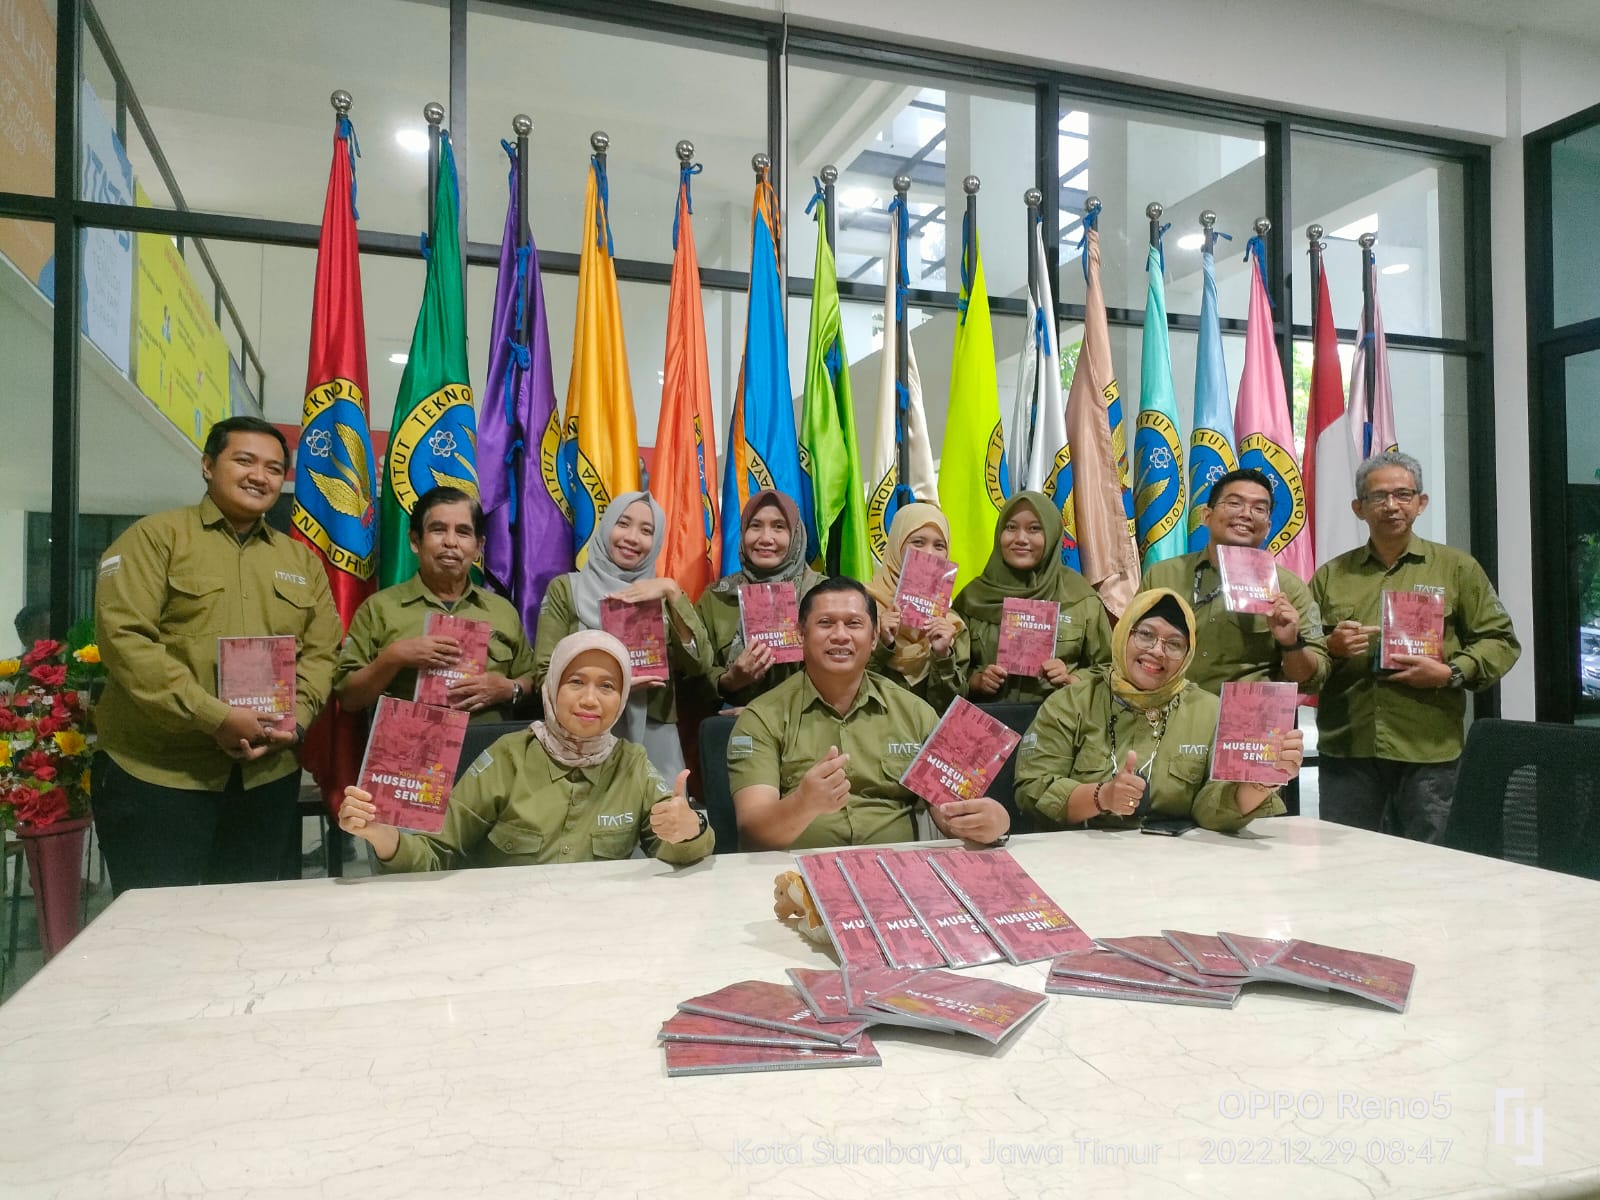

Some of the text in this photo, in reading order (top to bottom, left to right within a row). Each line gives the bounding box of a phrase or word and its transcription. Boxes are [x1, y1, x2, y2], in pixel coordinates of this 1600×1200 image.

[582, 467, 608, 520] BAYA
[274, 570, 306, 585] ITATS
[229, 695, 276, 706] MUSEUM
[888, 743, 921, 754] ITATS
[1223, 742, 1270, 752] MUSEUM
[1243, 752, 1269, 761] SENI
[927, 754, 968, 785] MUSEUM
[371, 772, 428, 791] MUSEUM
[940, 775, 964, 796] SENI
[394, 789, 426, 803] SENI
[597, 812, 634, 827] ITATS
[994, 910, 1047, 926] MUSEUM
[1026, 919, 1056, 932] SENI
[905, 989, 979, 1010] MUSEUM
